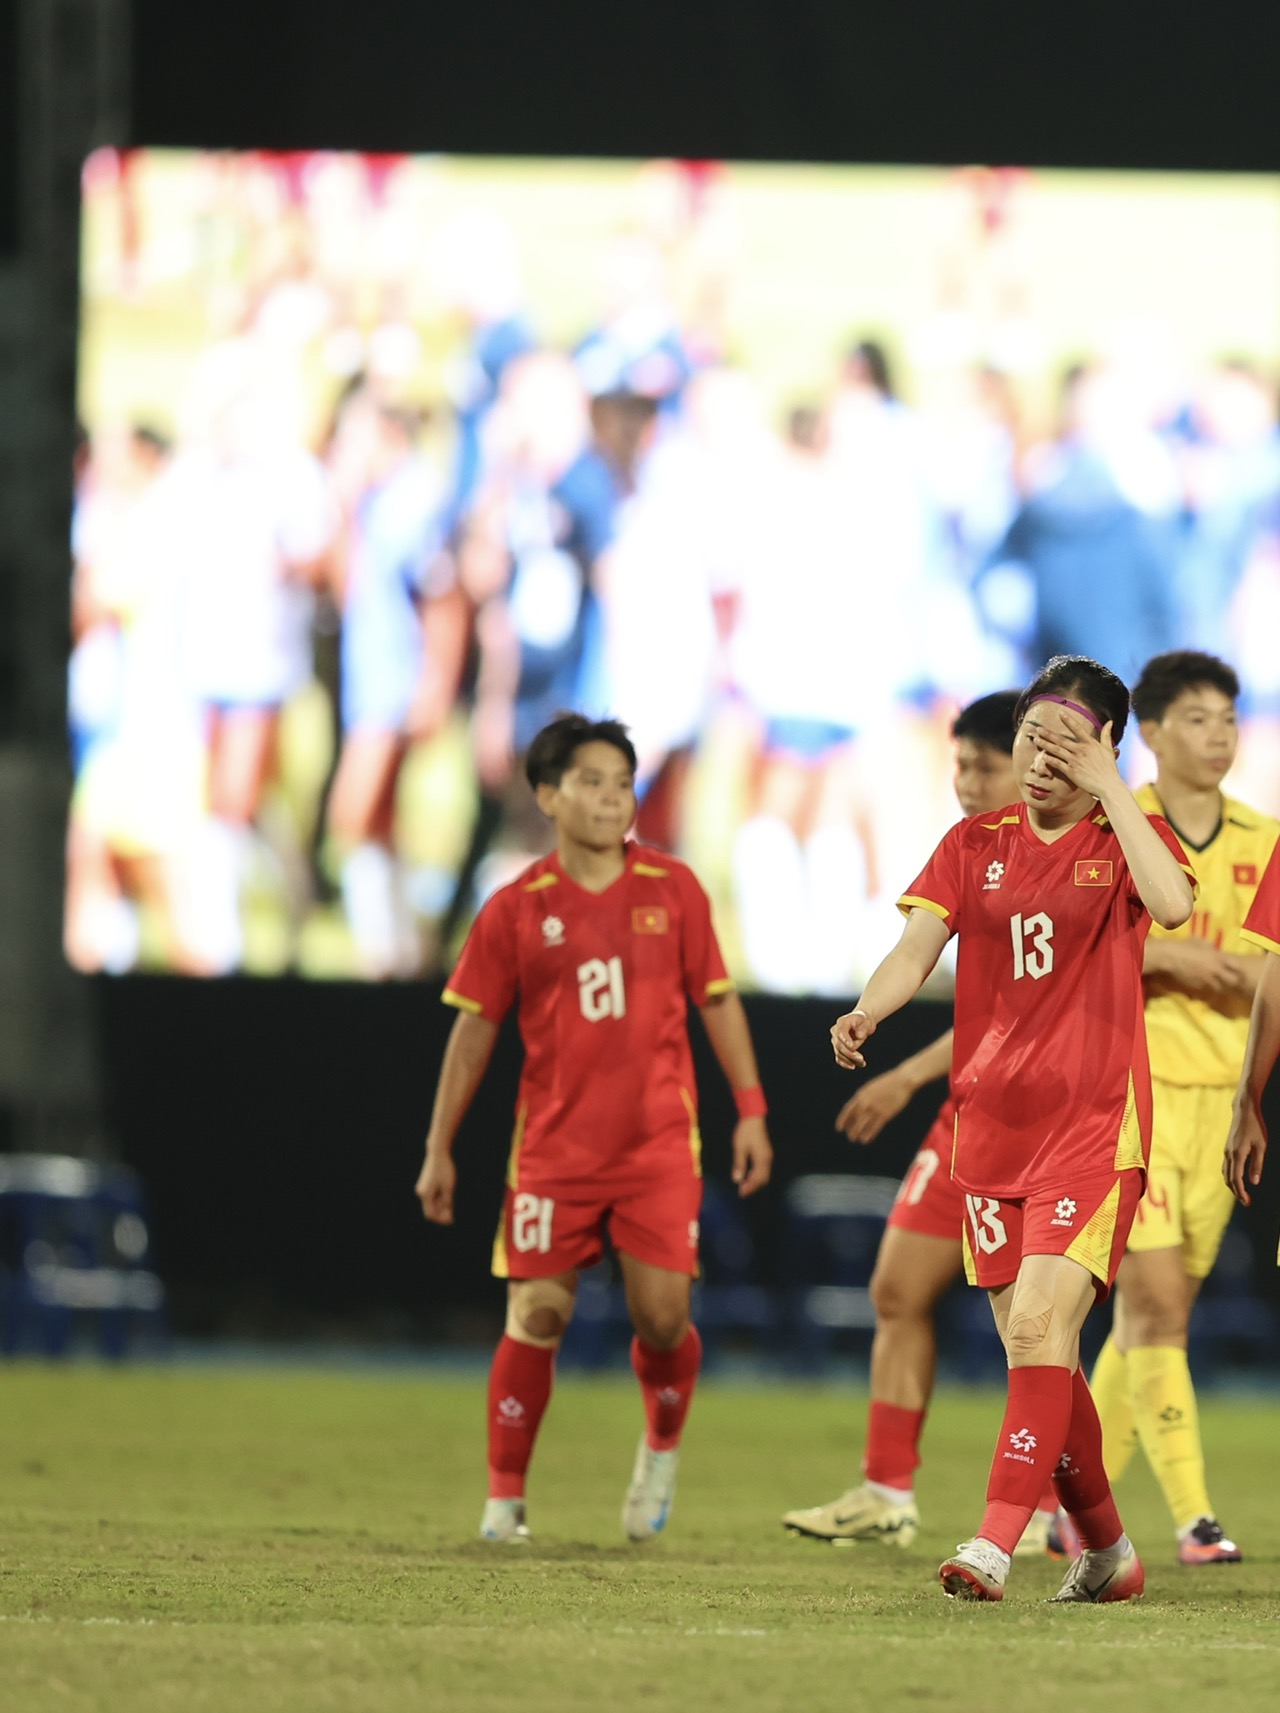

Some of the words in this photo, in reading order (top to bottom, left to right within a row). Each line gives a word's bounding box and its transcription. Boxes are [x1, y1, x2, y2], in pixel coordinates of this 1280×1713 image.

[1010, 912, 1055, 981] 13
[577, 956, 626, 1023] 21
[512, 1193, 555, 1254] 21
[965, 1193, 1008, 1256] 13
